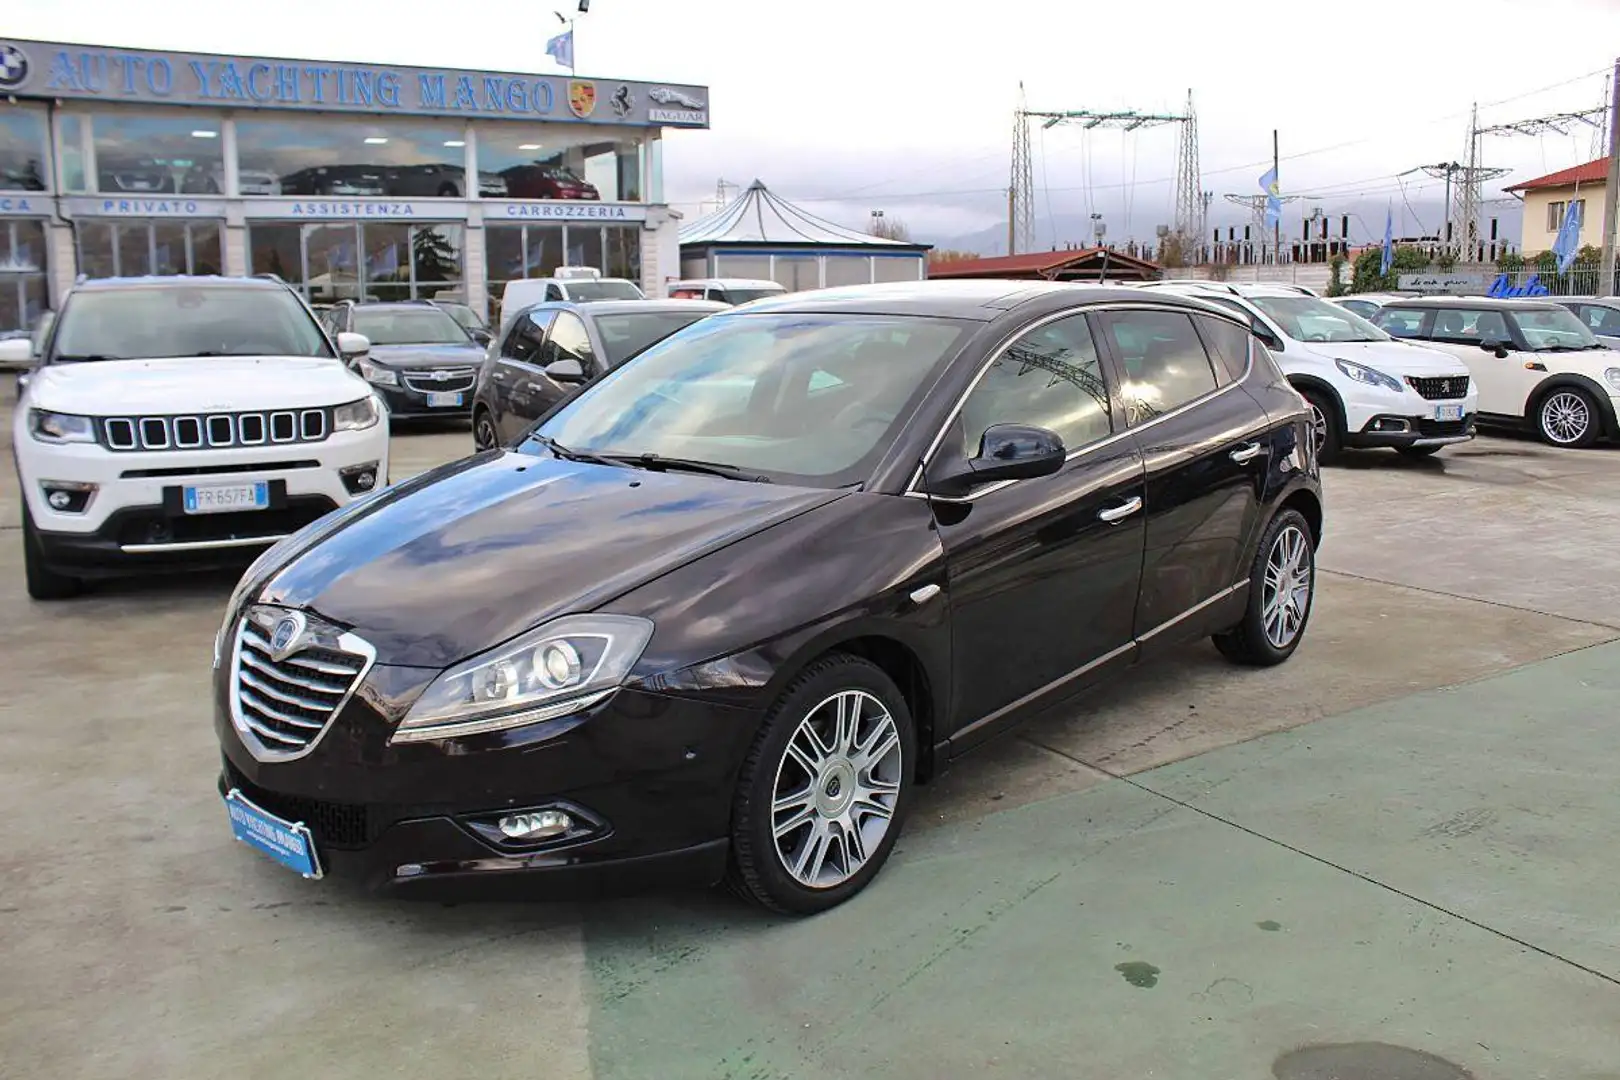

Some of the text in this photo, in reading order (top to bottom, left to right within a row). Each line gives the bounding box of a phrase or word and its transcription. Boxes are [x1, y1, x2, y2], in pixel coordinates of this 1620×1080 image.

[51, 52, 554, 113] AUTO YACHTING MANGO
[653, 110, 703, 121] JAGUAR
[104, 200, 197, 213] PRIVATO
[292, 204, 414, 216] ASSISTENZA
[507, 205, 626, 217] CARROZZERIA
